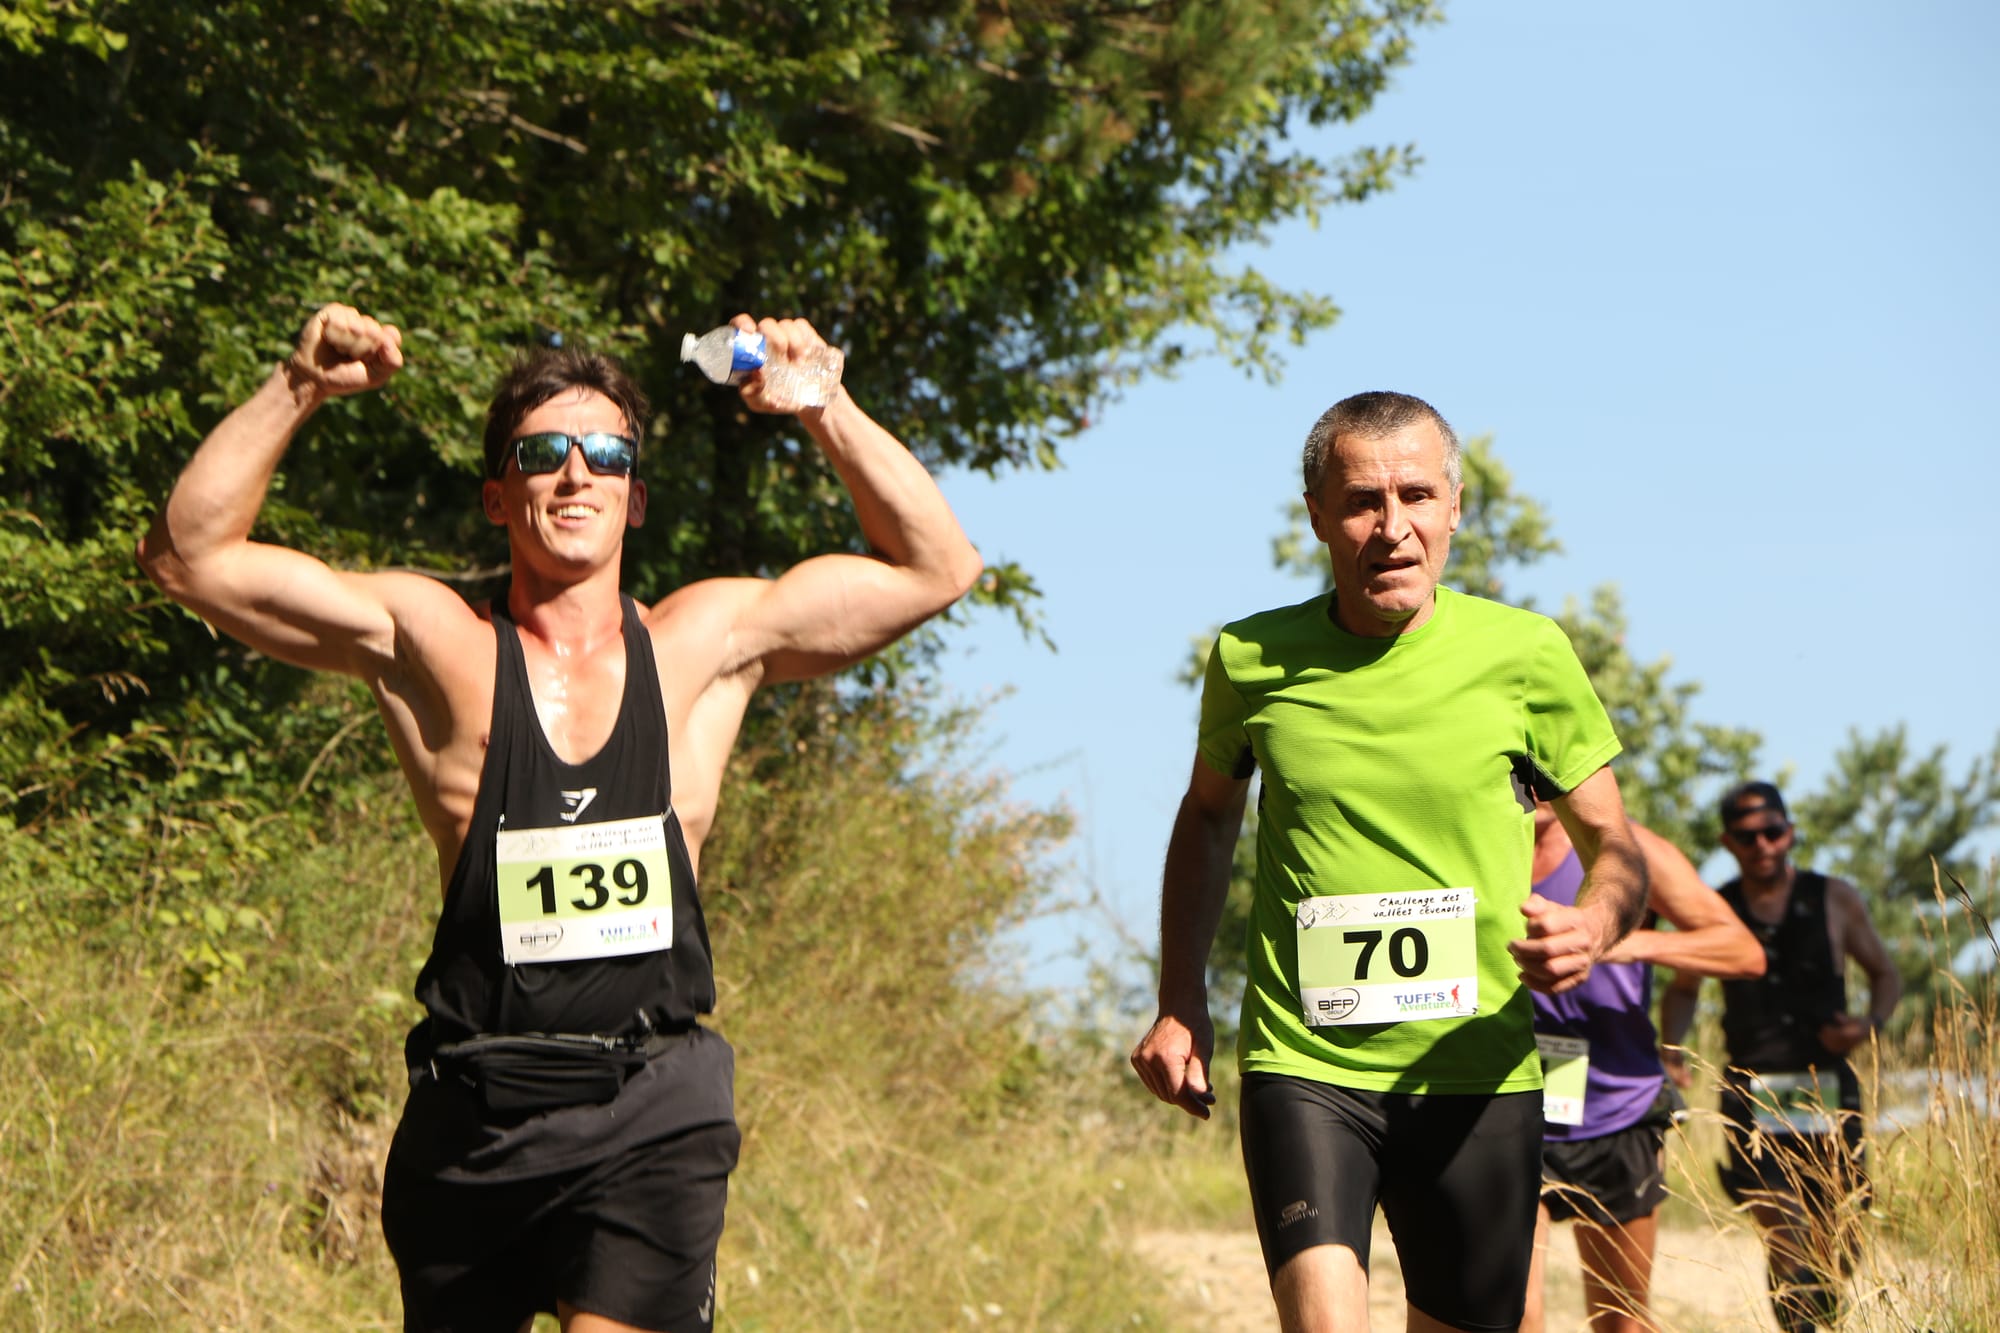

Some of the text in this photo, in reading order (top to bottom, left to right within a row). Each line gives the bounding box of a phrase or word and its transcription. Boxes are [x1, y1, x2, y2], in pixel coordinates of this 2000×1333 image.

[526, 859, 649, 916] 139
[1379, 893, 1460, 908] Challenge des
[1373, 906, 1412, 918] vallées
[1343, 927, 1429, 980] 70
[1318, 999, 1354, 1011] BFP
[1394, 991, 1446, 1005] TUFF'S
[1400, 1001, 1451, 1013] Aventure
